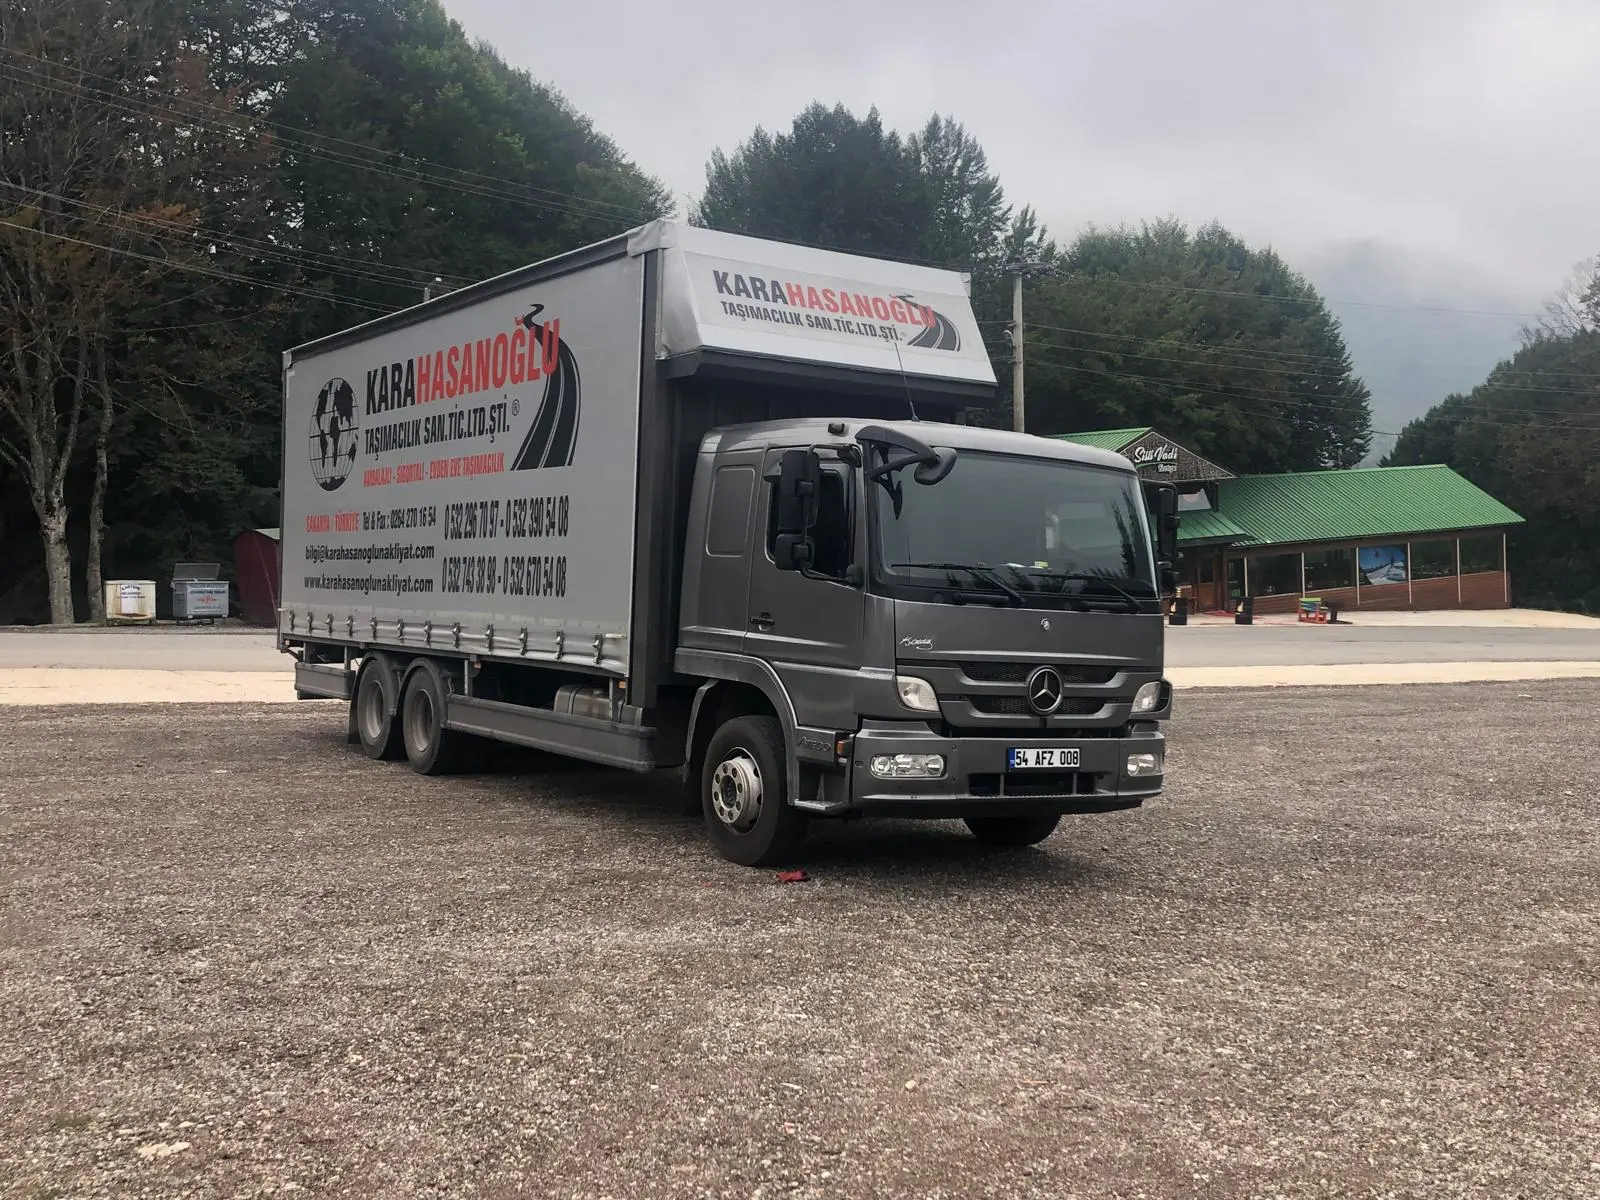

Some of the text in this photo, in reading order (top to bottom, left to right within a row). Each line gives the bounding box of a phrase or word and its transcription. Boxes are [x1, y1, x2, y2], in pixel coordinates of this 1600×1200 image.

[712, 269, 937, 328] KARAHASANOĞLU
[719, 300, 804, 326] TAŞIMACILIK
[366, 316, 561, 415] KARAHASANOĞLU
[365, 417, 421, 460] TAŞIMACILIK
[406, 508, 417, 528] 270
[419, 507, 426, 527] 16
[444, 503, 450, 540] 0
[450, 502, 463, 540] 532
[478, 500, 488, 538] 70
[489, 499, 500, 538] 97
[505, 498, 511, 538] 0
[512, 498, 527, 538] 532
[528, 496, 544, 538] 390
[545, 496, 556, 537] 54
[557, 494, 569, 537] 08
[304, 542, 435, 564] bilgi@karahasanoglunakliyat.com
[303, 574, 434, 596] www.karahasanoglunakliyat.com
[442, 556, 447, 593] 0
[447, 556, 461, 593] 532
[461, 556, 475, 594] 743
[475, 555, 486, 594] 38
[502, 555, 509, 595] 0
[509, 555, 525, 596] 532
[526, 555, 541, 597] 670
[542, 556, 554, 597] 54
[555, 555, 567, 598] 08
[1015, 750, 1079, 766] 54 AFZ 008
